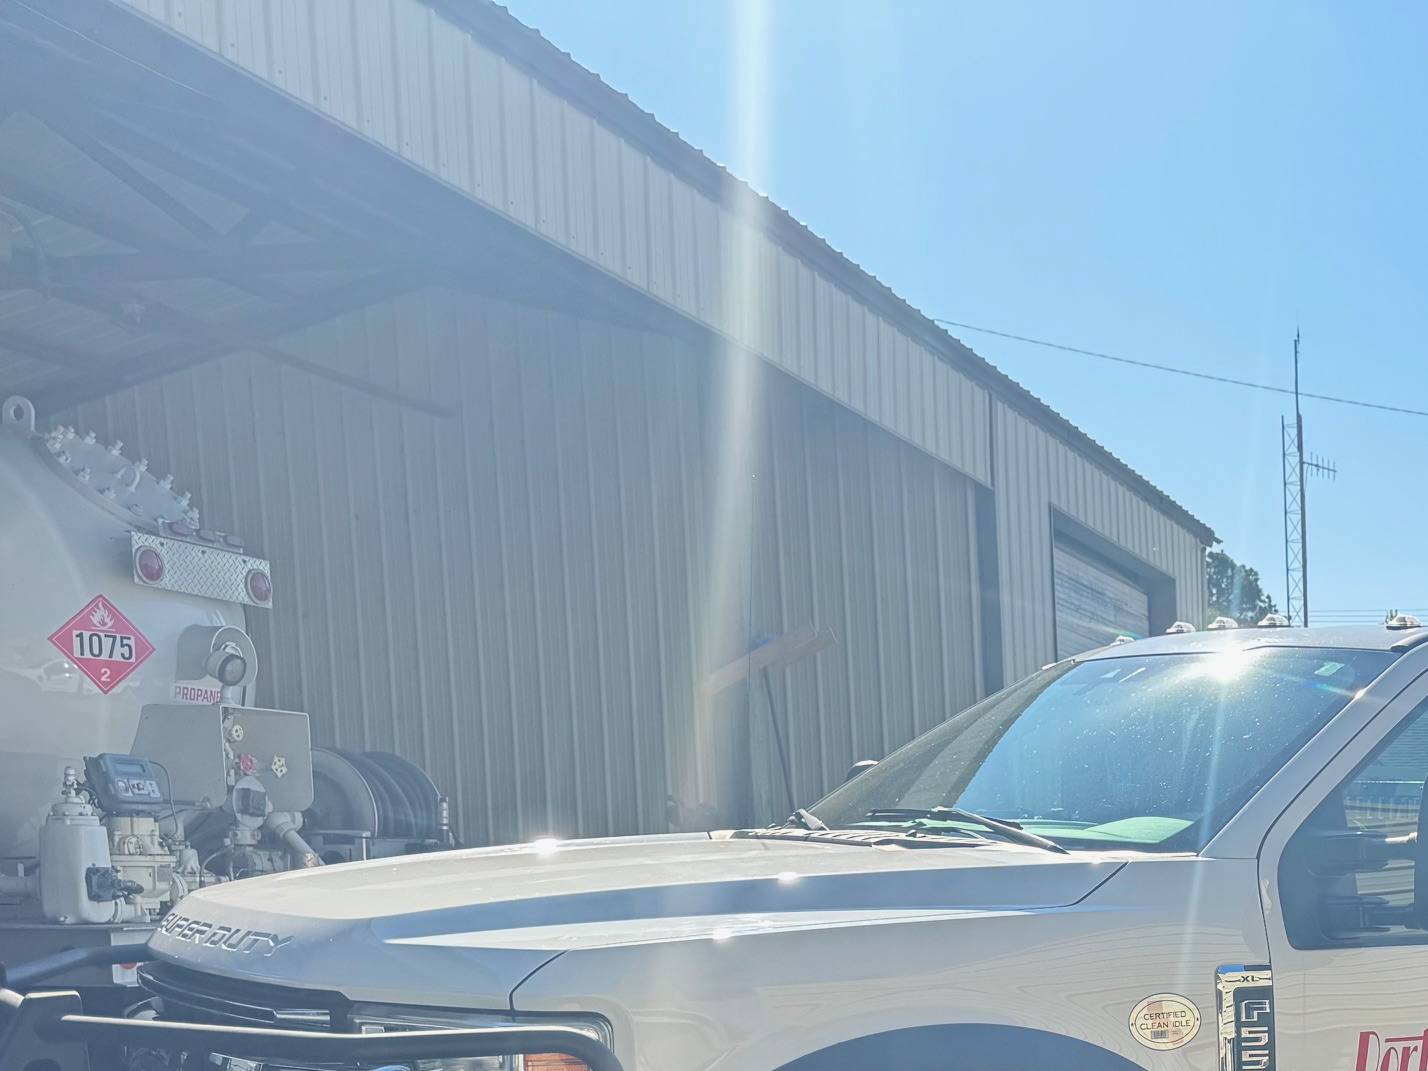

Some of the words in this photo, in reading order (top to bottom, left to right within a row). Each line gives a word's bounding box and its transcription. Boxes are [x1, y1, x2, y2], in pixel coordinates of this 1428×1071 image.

[75, 632, 133, 661] 1075
[101, 668, 111, 682] 2
[161, 912, 213, 944] SUPER
[203, 925, 295, 957] DUTY
[1143, 1010, 1187, 1021] CERTIFIED
[1140, 1021, 1169, 1031] CLEAN
[1172, 1019, 1191, 1028] IDLE
